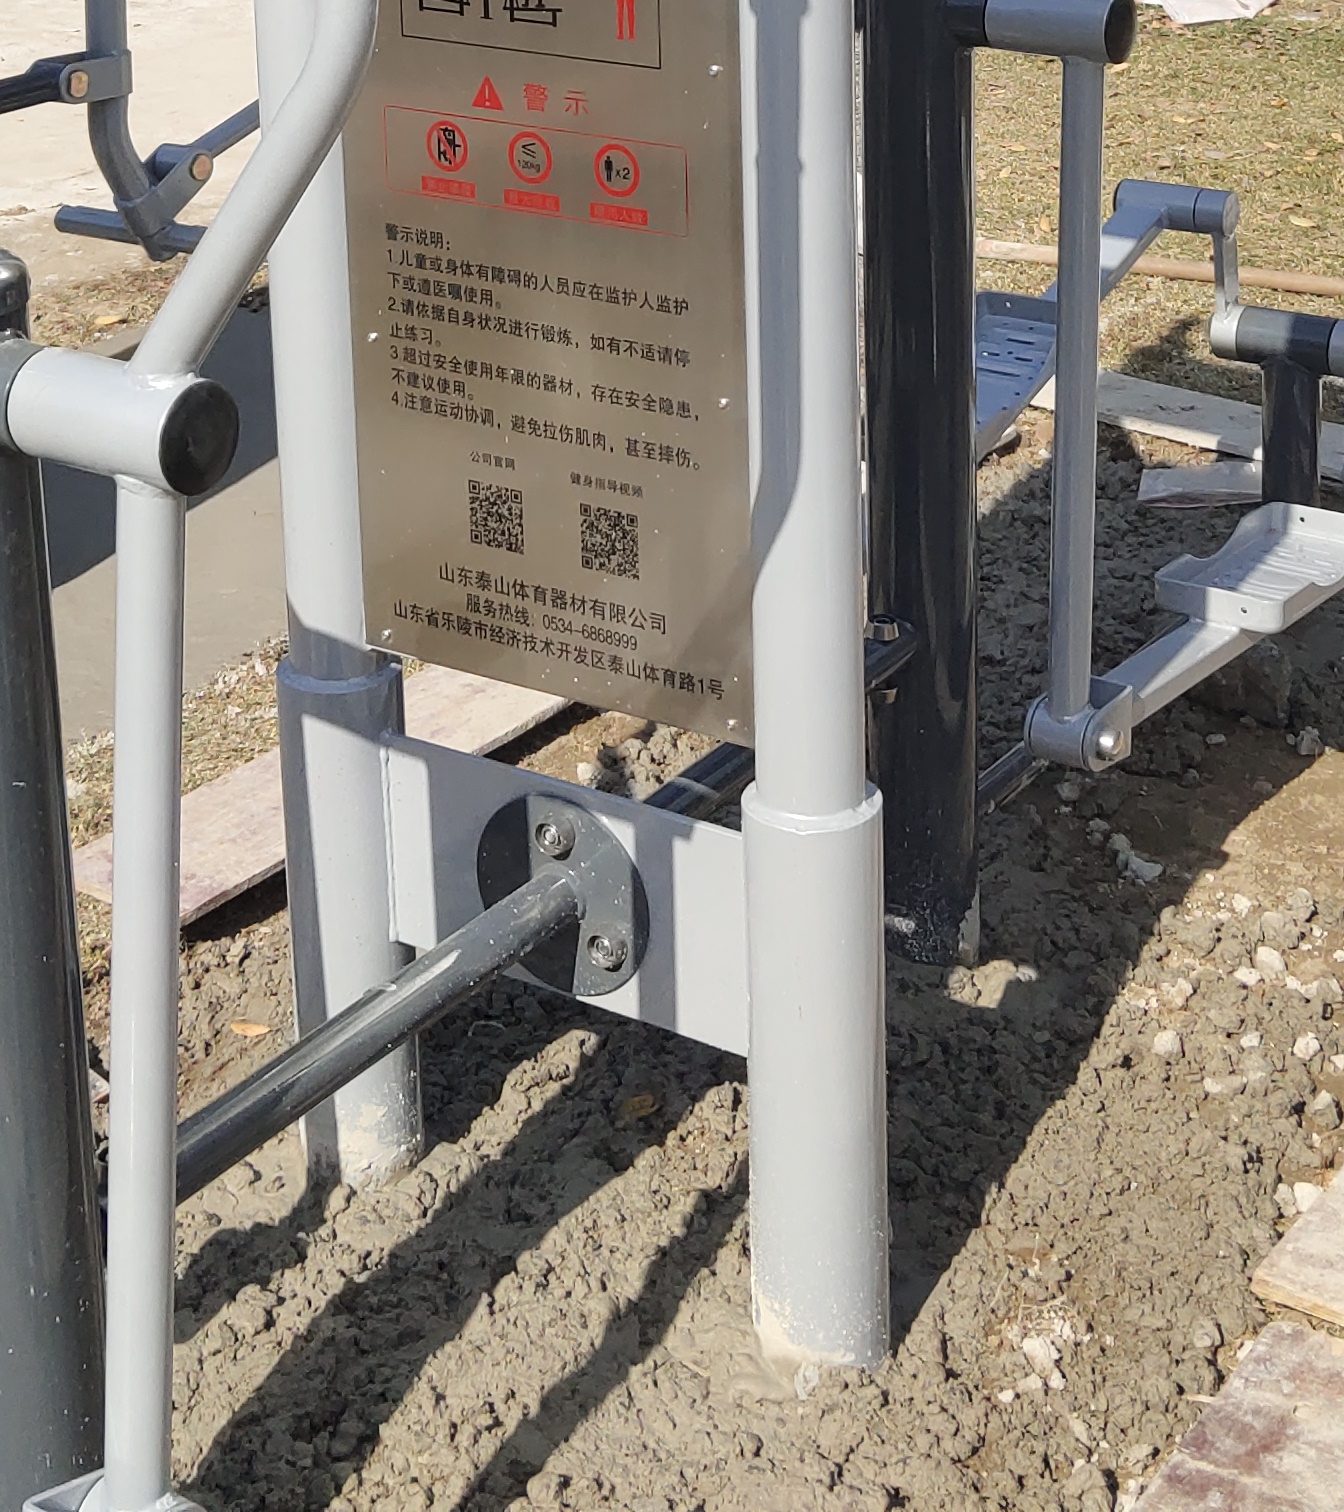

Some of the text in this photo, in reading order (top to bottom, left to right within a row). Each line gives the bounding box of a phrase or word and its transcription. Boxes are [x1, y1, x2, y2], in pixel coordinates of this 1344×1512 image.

[523, 83, 589, 116] 警示
[385, 223, 452, 250] 警示说明：
[387, 249, 689, 316] 1.儿童或身体有障碍的人员应在监护人监护
[387, 271, 502, 309] 下或遵医嘱使用。
[387, 296, 691, 368] 2.请依据自身状况进行锻炼，如有不适请停
[389, 322, 441, 347] 止练习。
[391, 367, 474, 400] 不建议使用。
[469, 450, 516, 471] 公司官网
[439, 562, 667, 634] 山东泰山体育器材有限公司
[393, 599, 725, 701] 山东省乐陵市经济技术开发区泰山体育路1号
